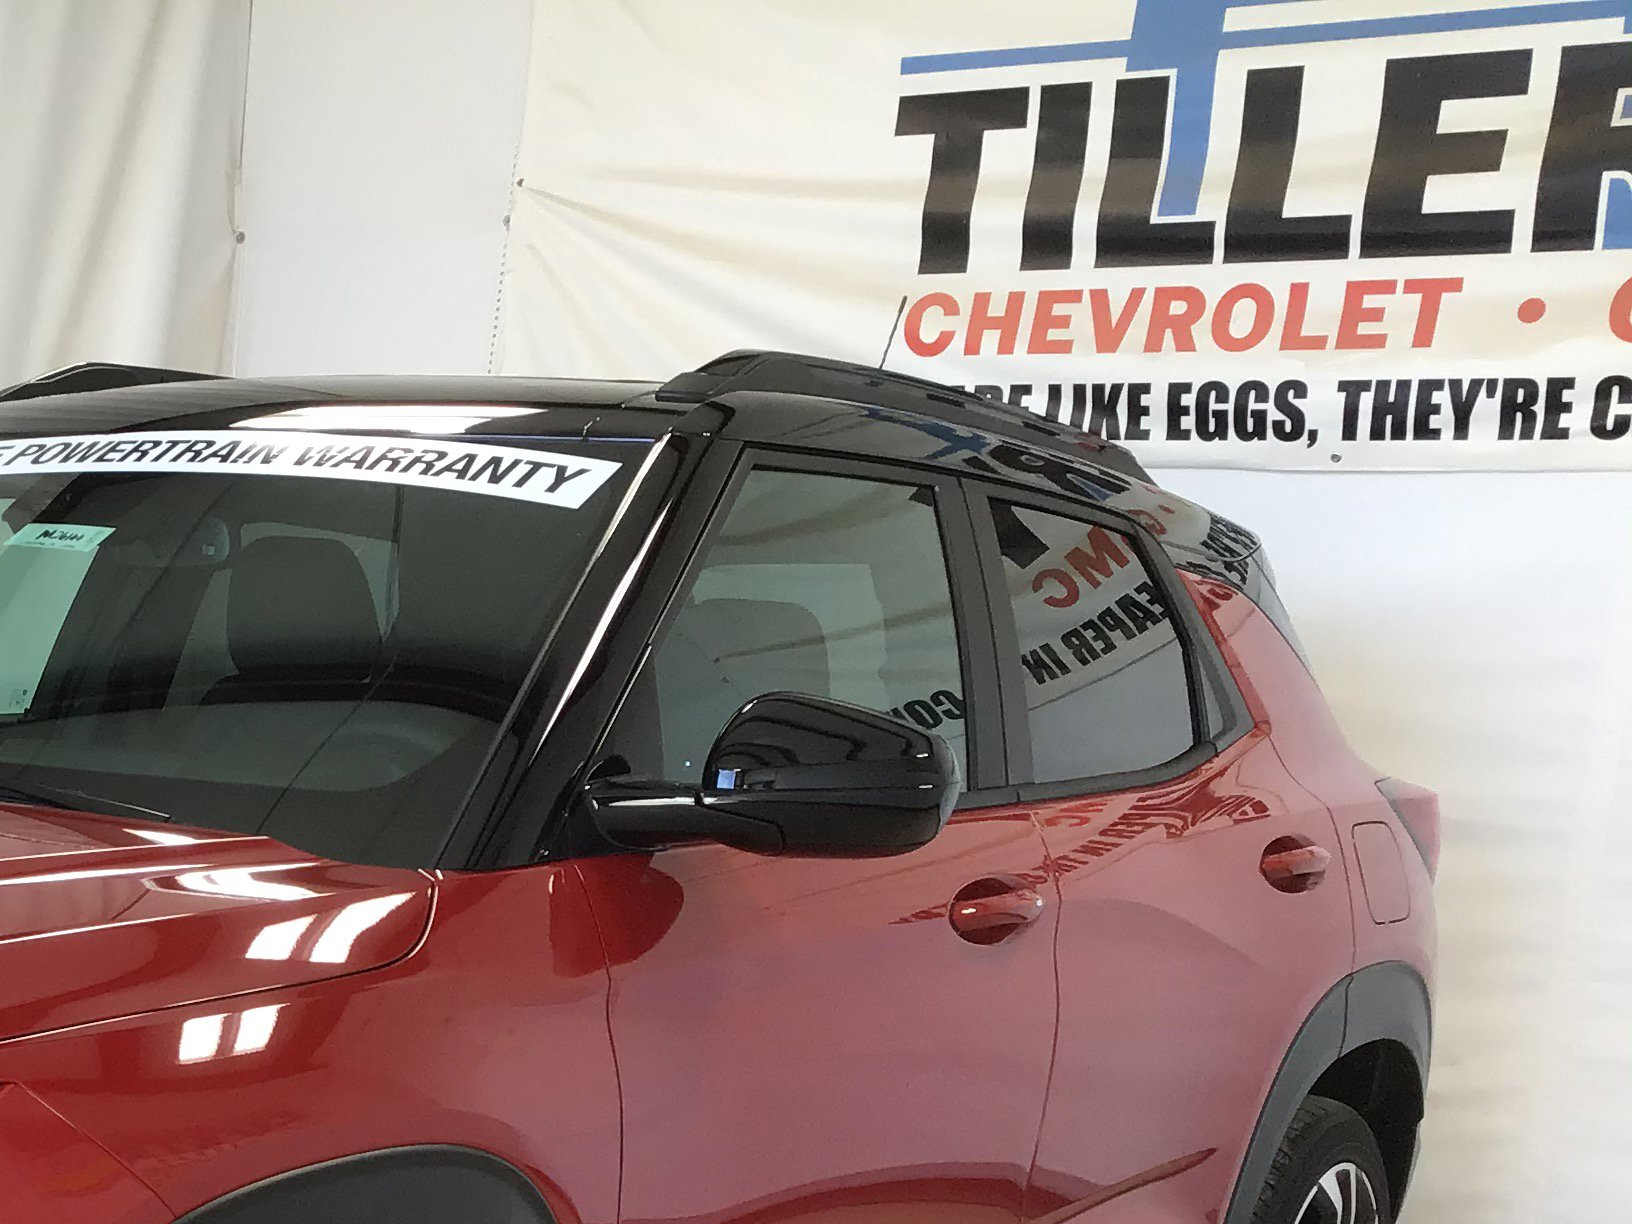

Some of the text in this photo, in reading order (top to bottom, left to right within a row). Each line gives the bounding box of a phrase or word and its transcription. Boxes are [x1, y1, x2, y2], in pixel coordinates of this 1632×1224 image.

[903, 277, 1464, 357] CHEVROLET
[1165, 379, 1319, 449] EGGS,
[1335, 376, 1576, 442] THEY'RE
[3, 439, 287, 467] POWERTRAIN
[293, 443, 590, 494] WARRANTY
